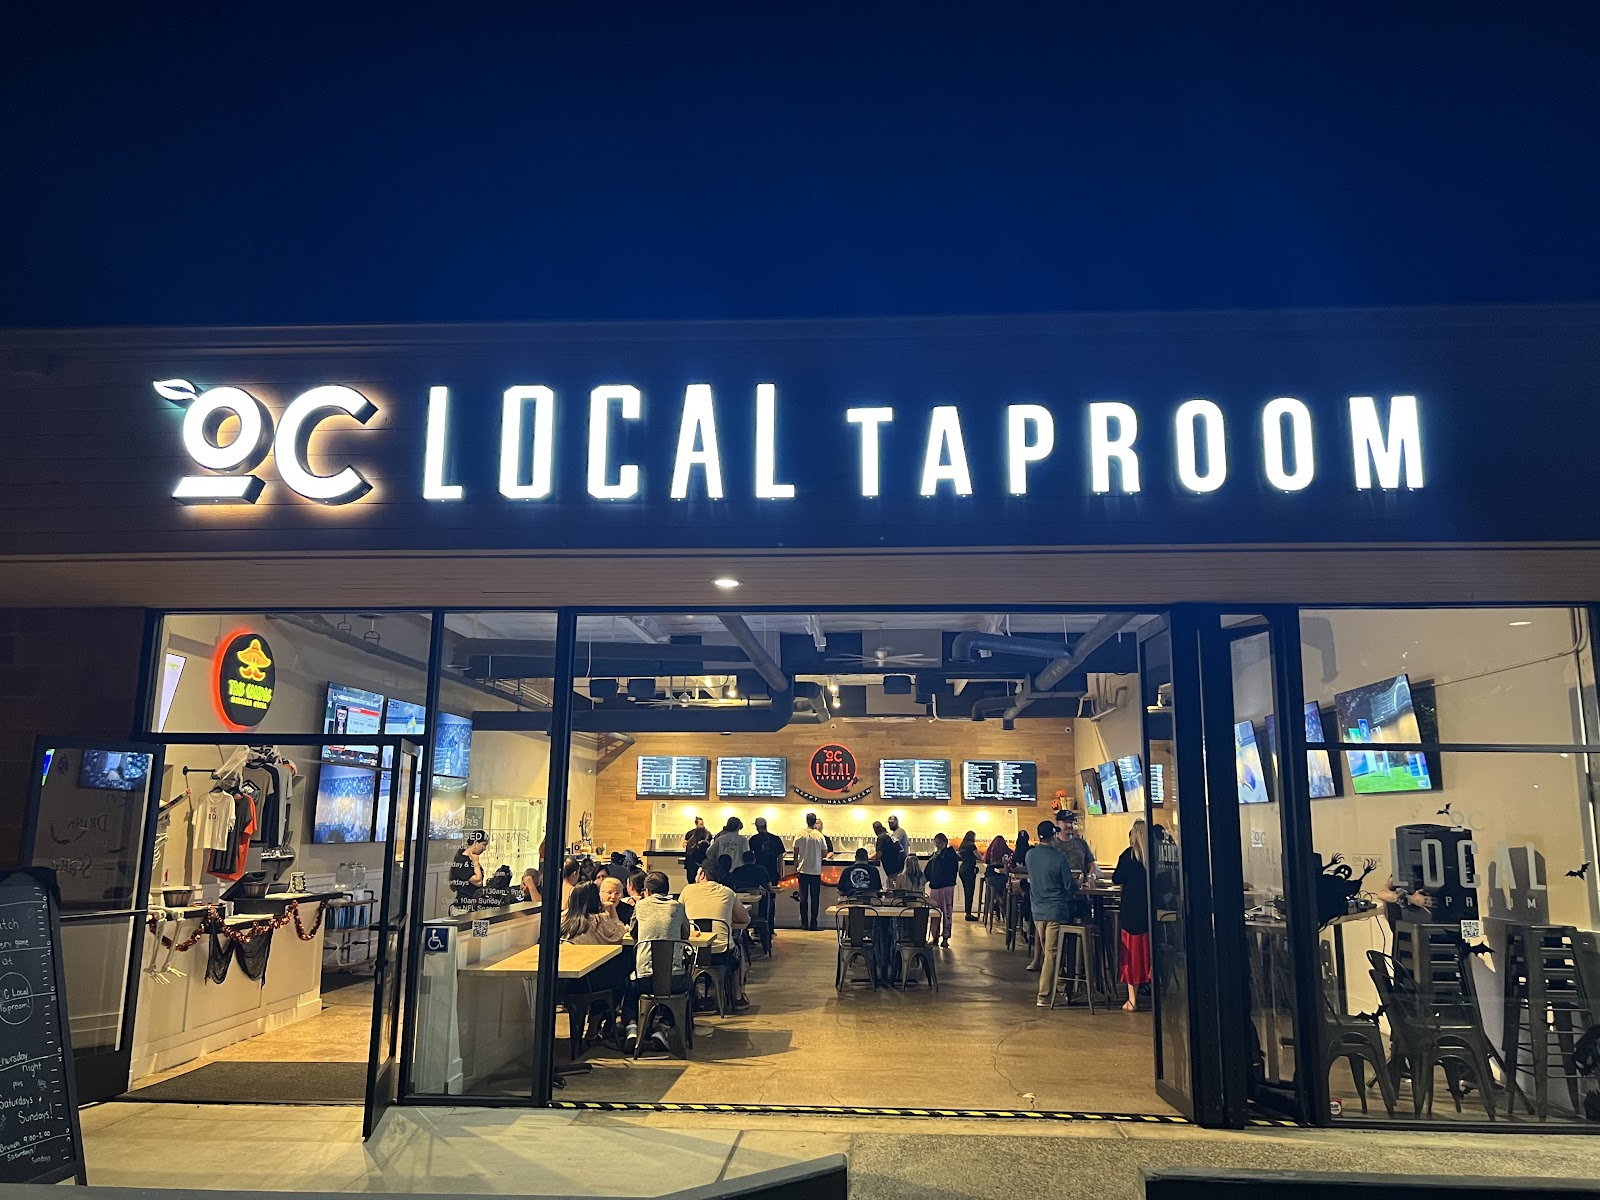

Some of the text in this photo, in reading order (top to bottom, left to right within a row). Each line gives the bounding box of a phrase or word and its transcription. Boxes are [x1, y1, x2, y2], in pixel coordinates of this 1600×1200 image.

[172, 383, 1426, 506] OC LOCAL TAPROOM
[825, 750, 843, 762] OC
[815, 762, 851, 776] LOCAL
[795, 787, 872, 804] HAPPY HALLOWEEN
[447, 818, 479, 827] HOURS
[1389, 838, 1547, 890] LOCAL
[2, 957, 14, 966] at
[11, 986, 30, 997] Local
[17, 1103, 53, 1125] Sundays!
